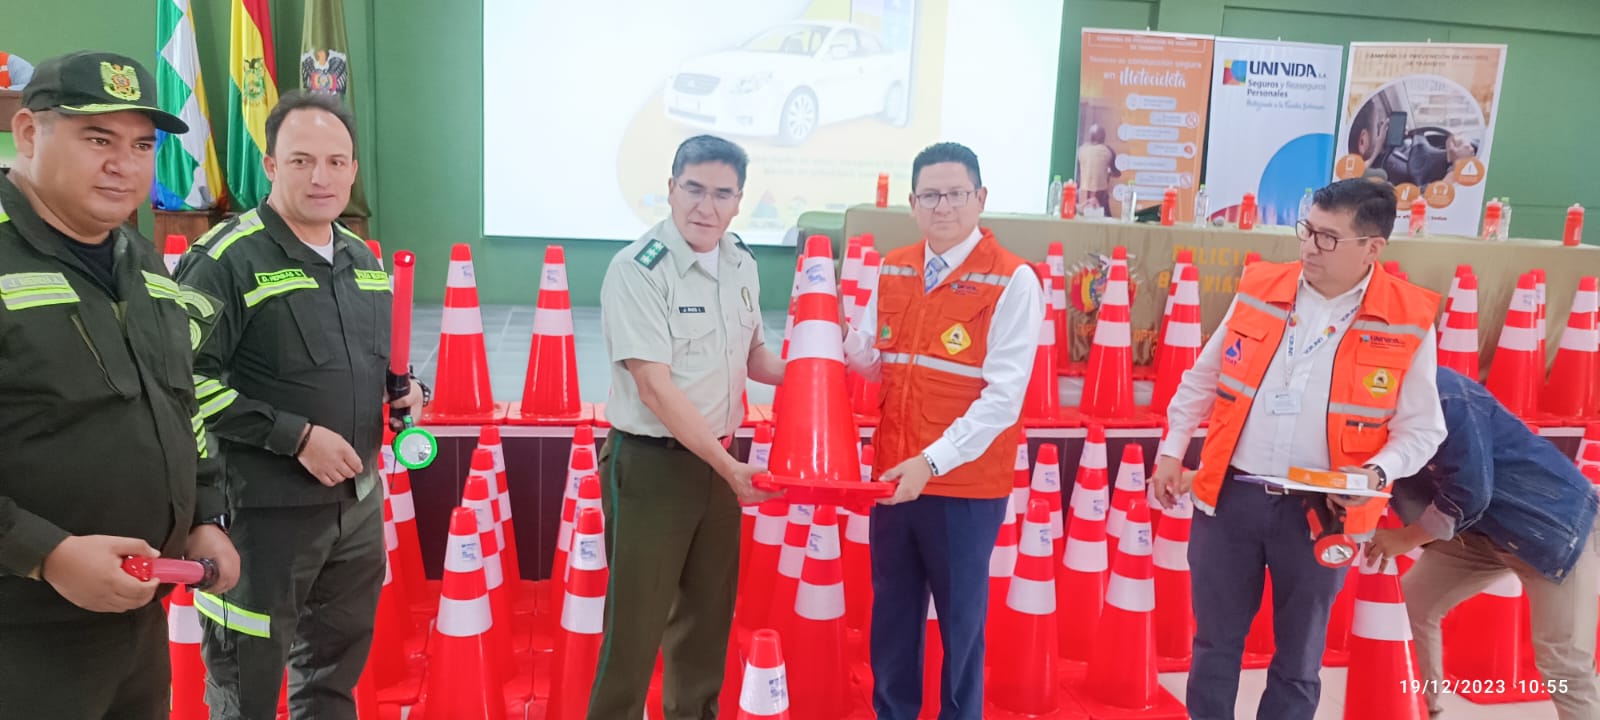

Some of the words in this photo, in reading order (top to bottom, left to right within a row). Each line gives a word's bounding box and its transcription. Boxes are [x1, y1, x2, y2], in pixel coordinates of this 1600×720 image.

[1249, 60, 1317, 78] UNIVIDA
[1247, 79, 1279, 89] Seguros
[1247, 88, 1288, 98] Personales
